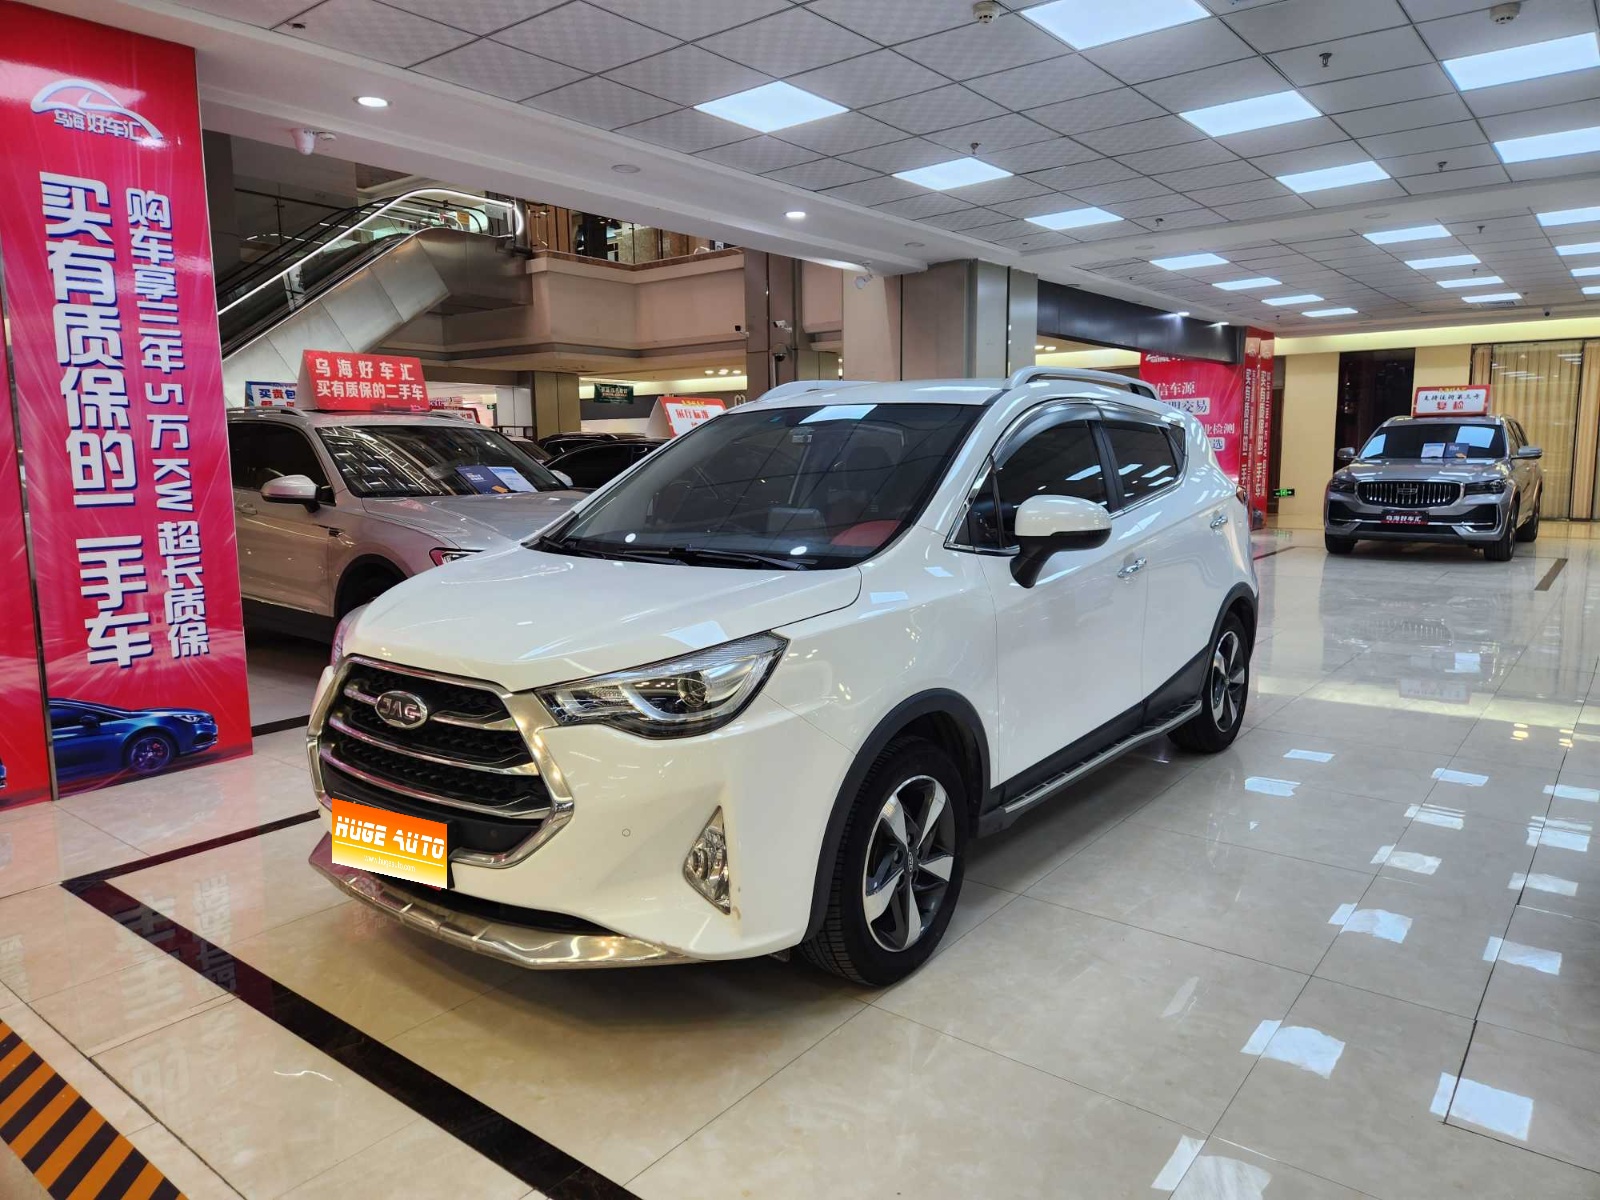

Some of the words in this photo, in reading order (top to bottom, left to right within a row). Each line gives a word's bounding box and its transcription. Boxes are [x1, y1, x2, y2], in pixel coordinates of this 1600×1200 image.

[315, 358, 415, 381] 乌海好车汇
[316, 380, 424, 400] 买有质保的二手车
[39, 171, 153, 668] 买有质保的二手车
[378, 696, 423, 722] JAC
